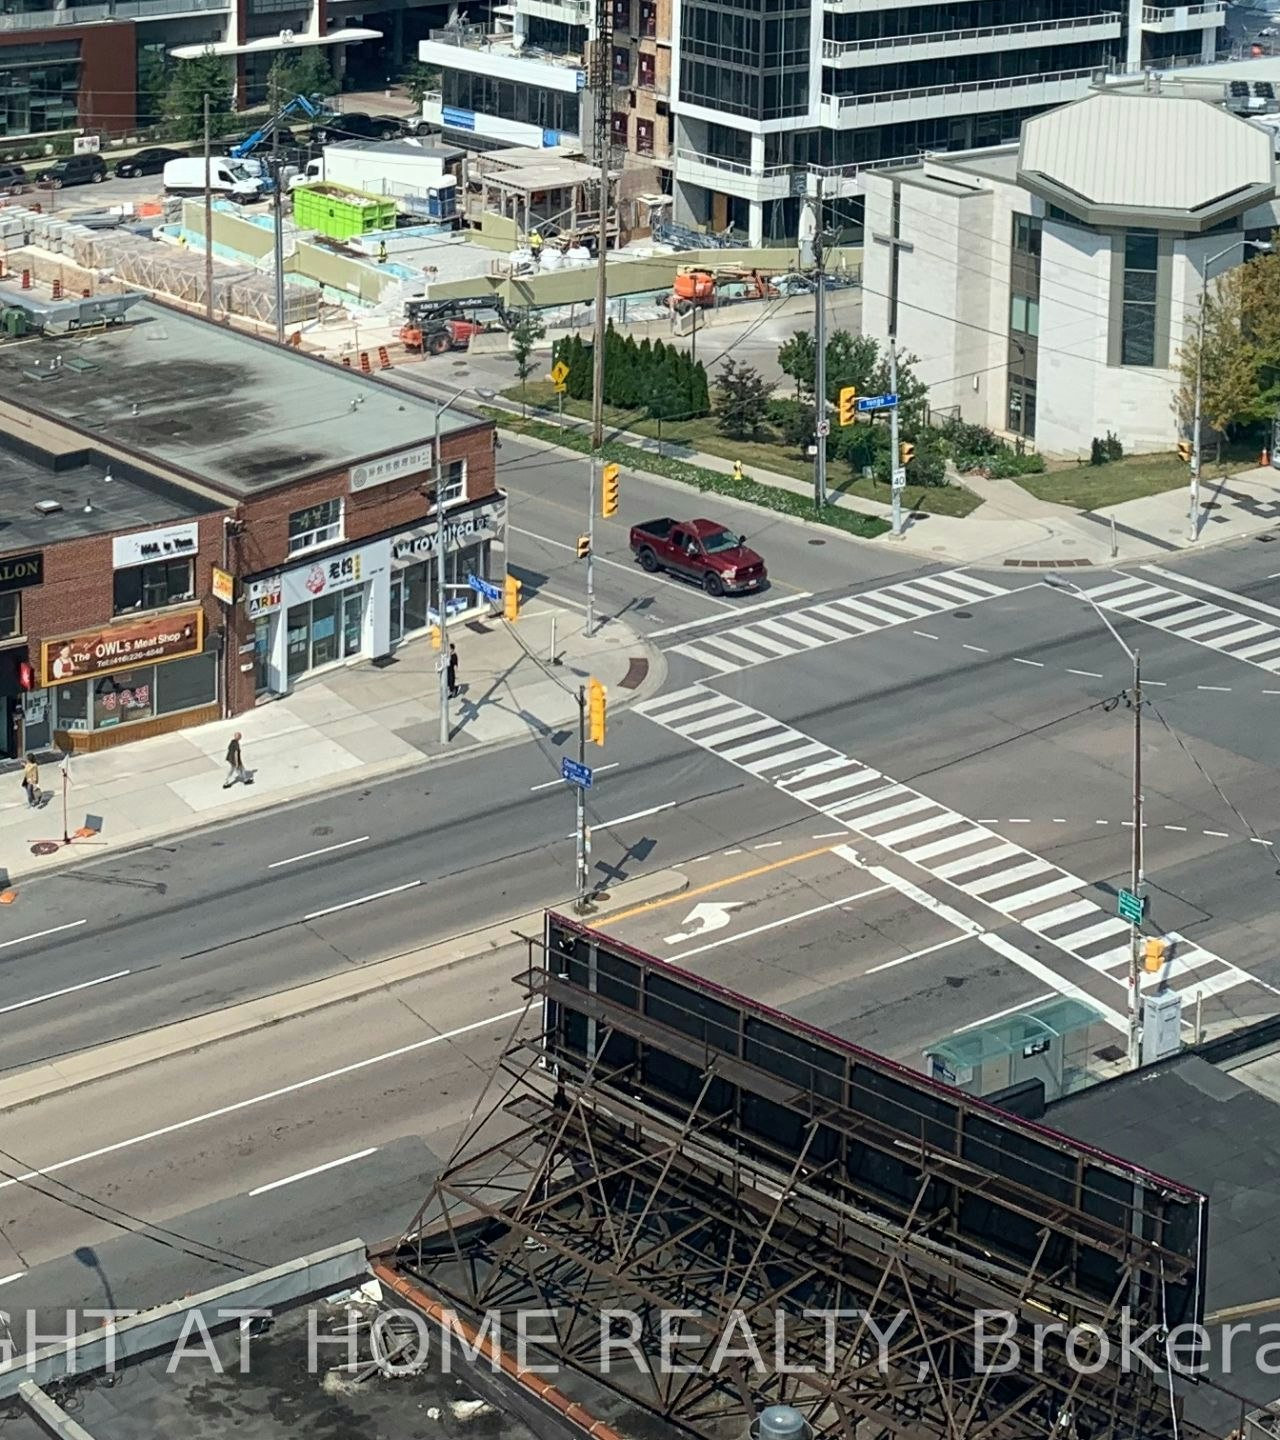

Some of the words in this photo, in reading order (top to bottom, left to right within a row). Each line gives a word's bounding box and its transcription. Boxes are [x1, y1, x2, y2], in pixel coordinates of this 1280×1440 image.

[73, 651, 90, 663] The
[134, 637, 157, 650] Meat
[158, 632, 181, 647] Shop
